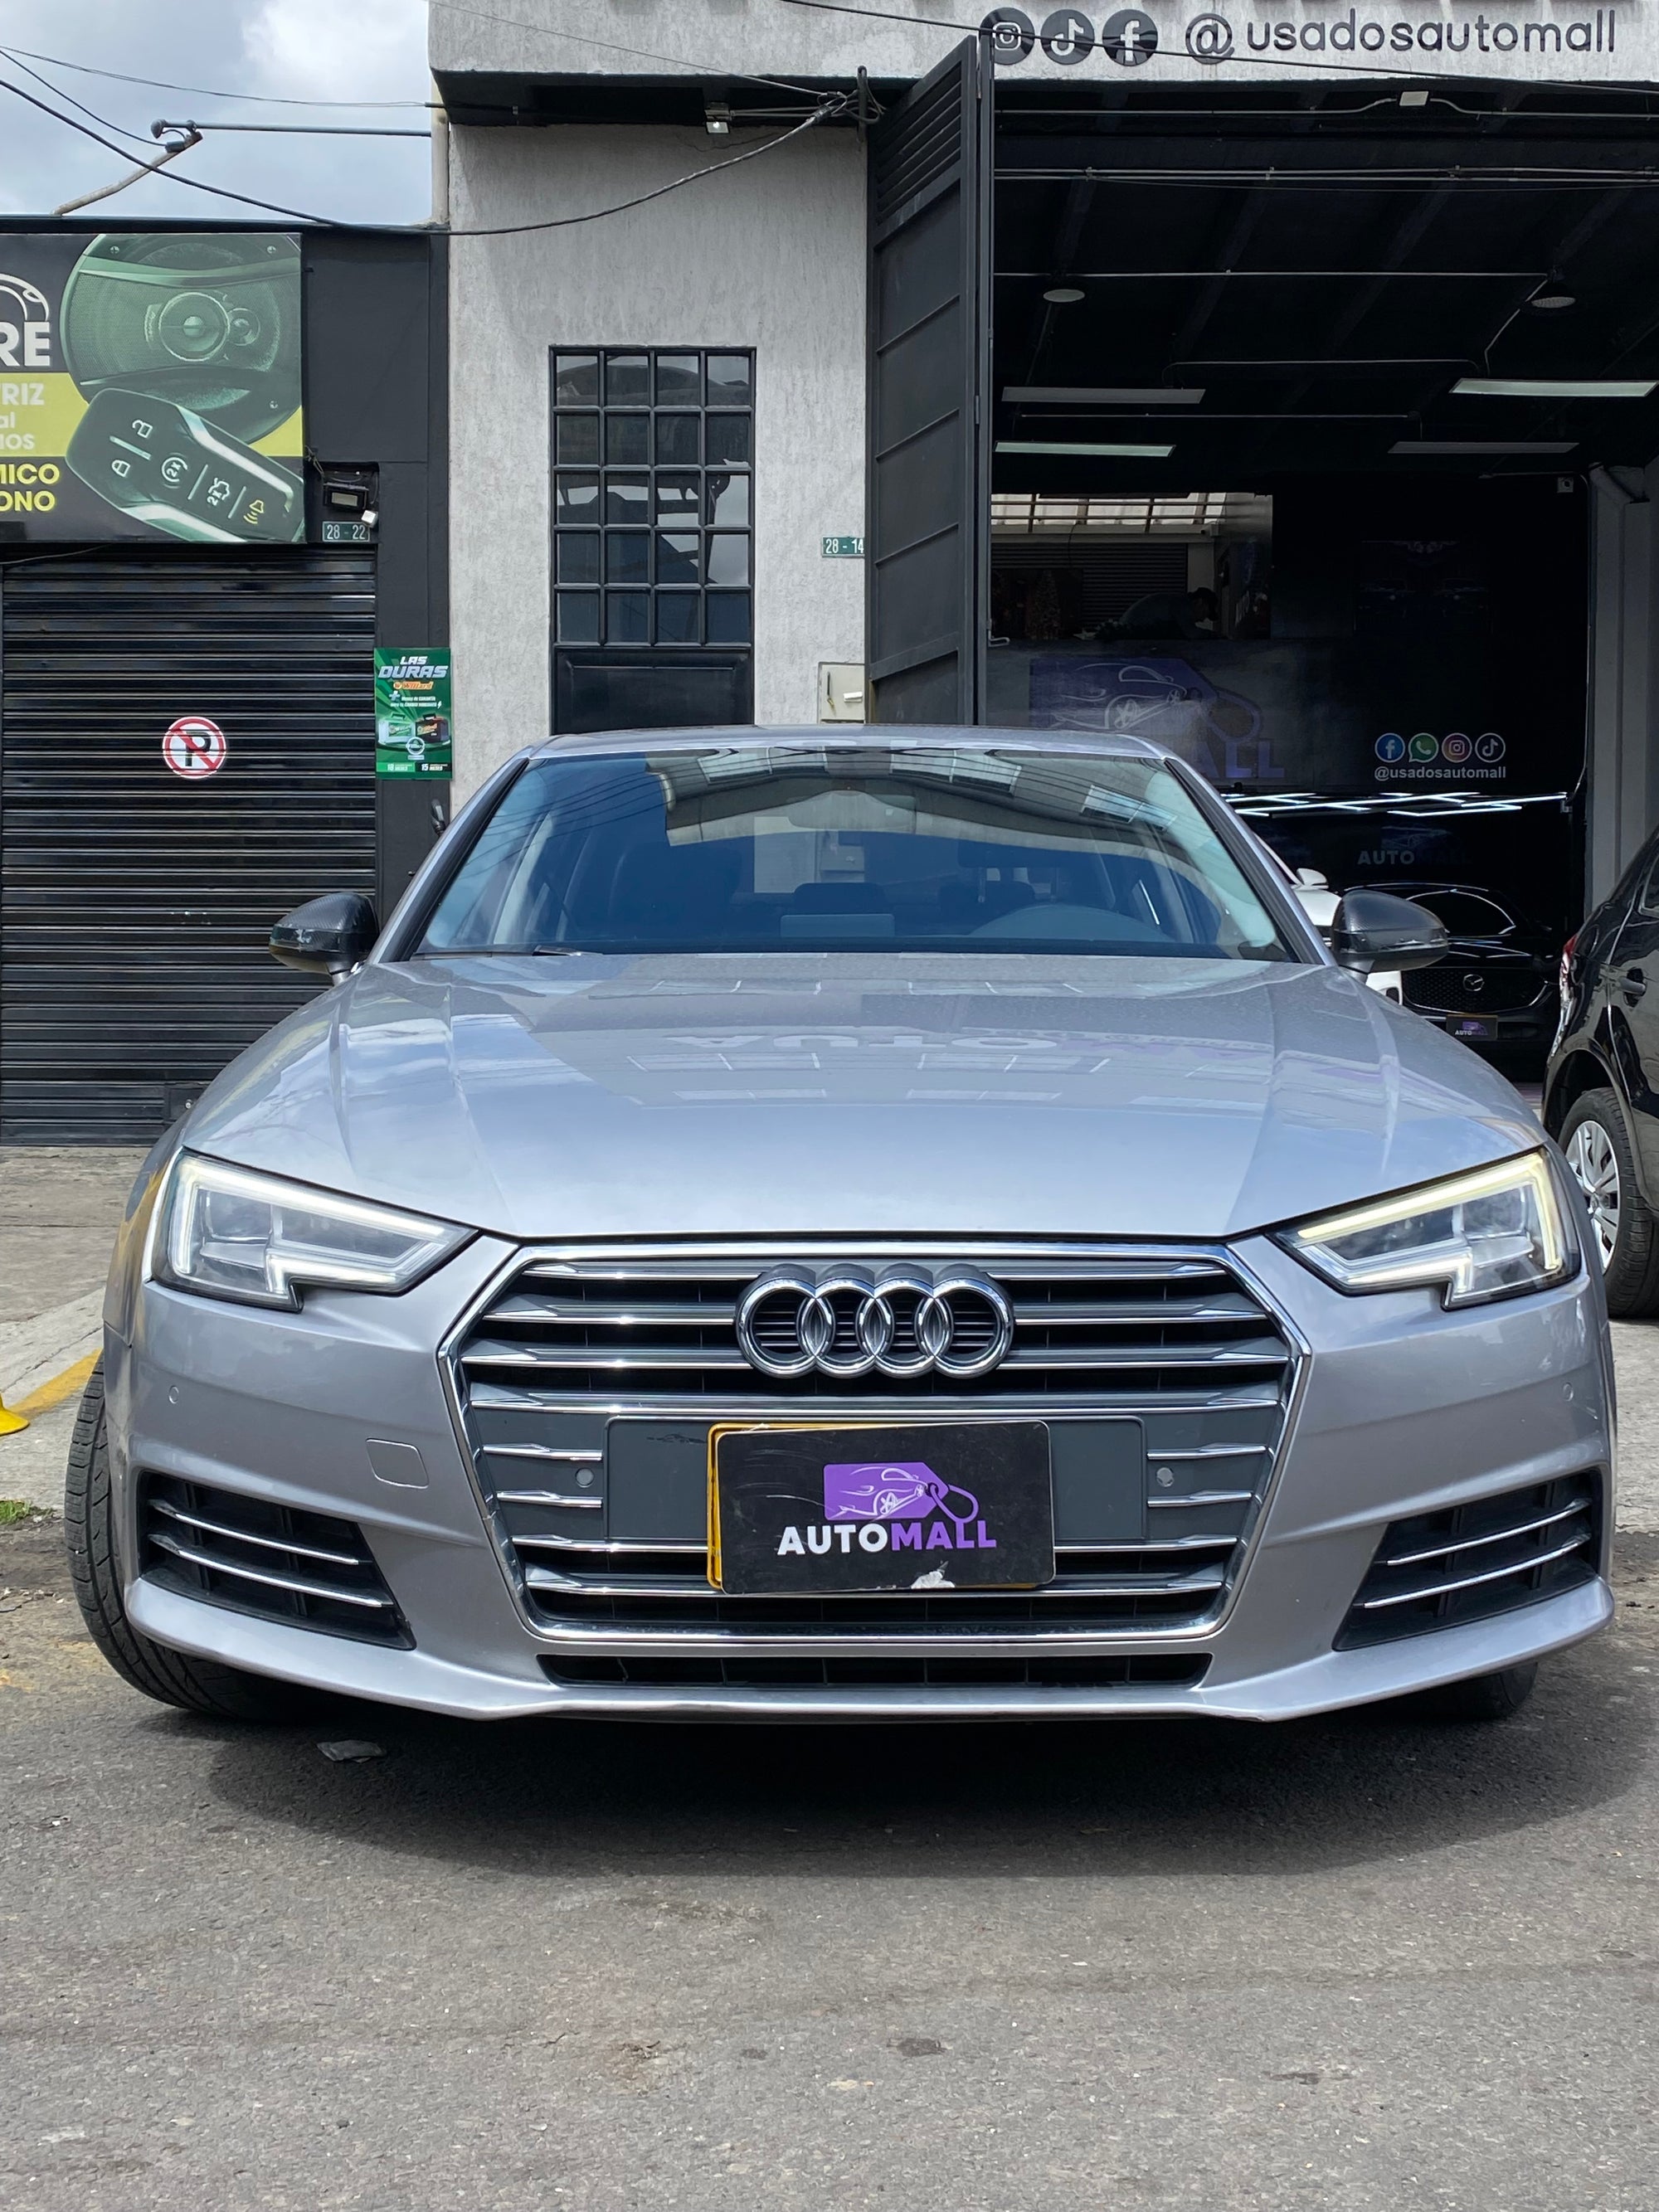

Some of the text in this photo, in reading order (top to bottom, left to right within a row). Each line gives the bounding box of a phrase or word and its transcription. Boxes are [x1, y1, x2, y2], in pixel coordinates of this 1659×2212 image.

[0, 382, 45, 406] RIZ
[327, 524, 340, 539] 28
[353, 524, 365, 539] 22
[825, 538, 839, 553] 28
[851, 538, 864, 553] 14
[400, 656, 428, 665] LAS
[378, 665, 449, 678] DURAS
[421, 763, 429, 771] 15
[1374, 766, 1506, 781] @usadosautomall
[776, 1519, 996, 1556] AUTOMALL
